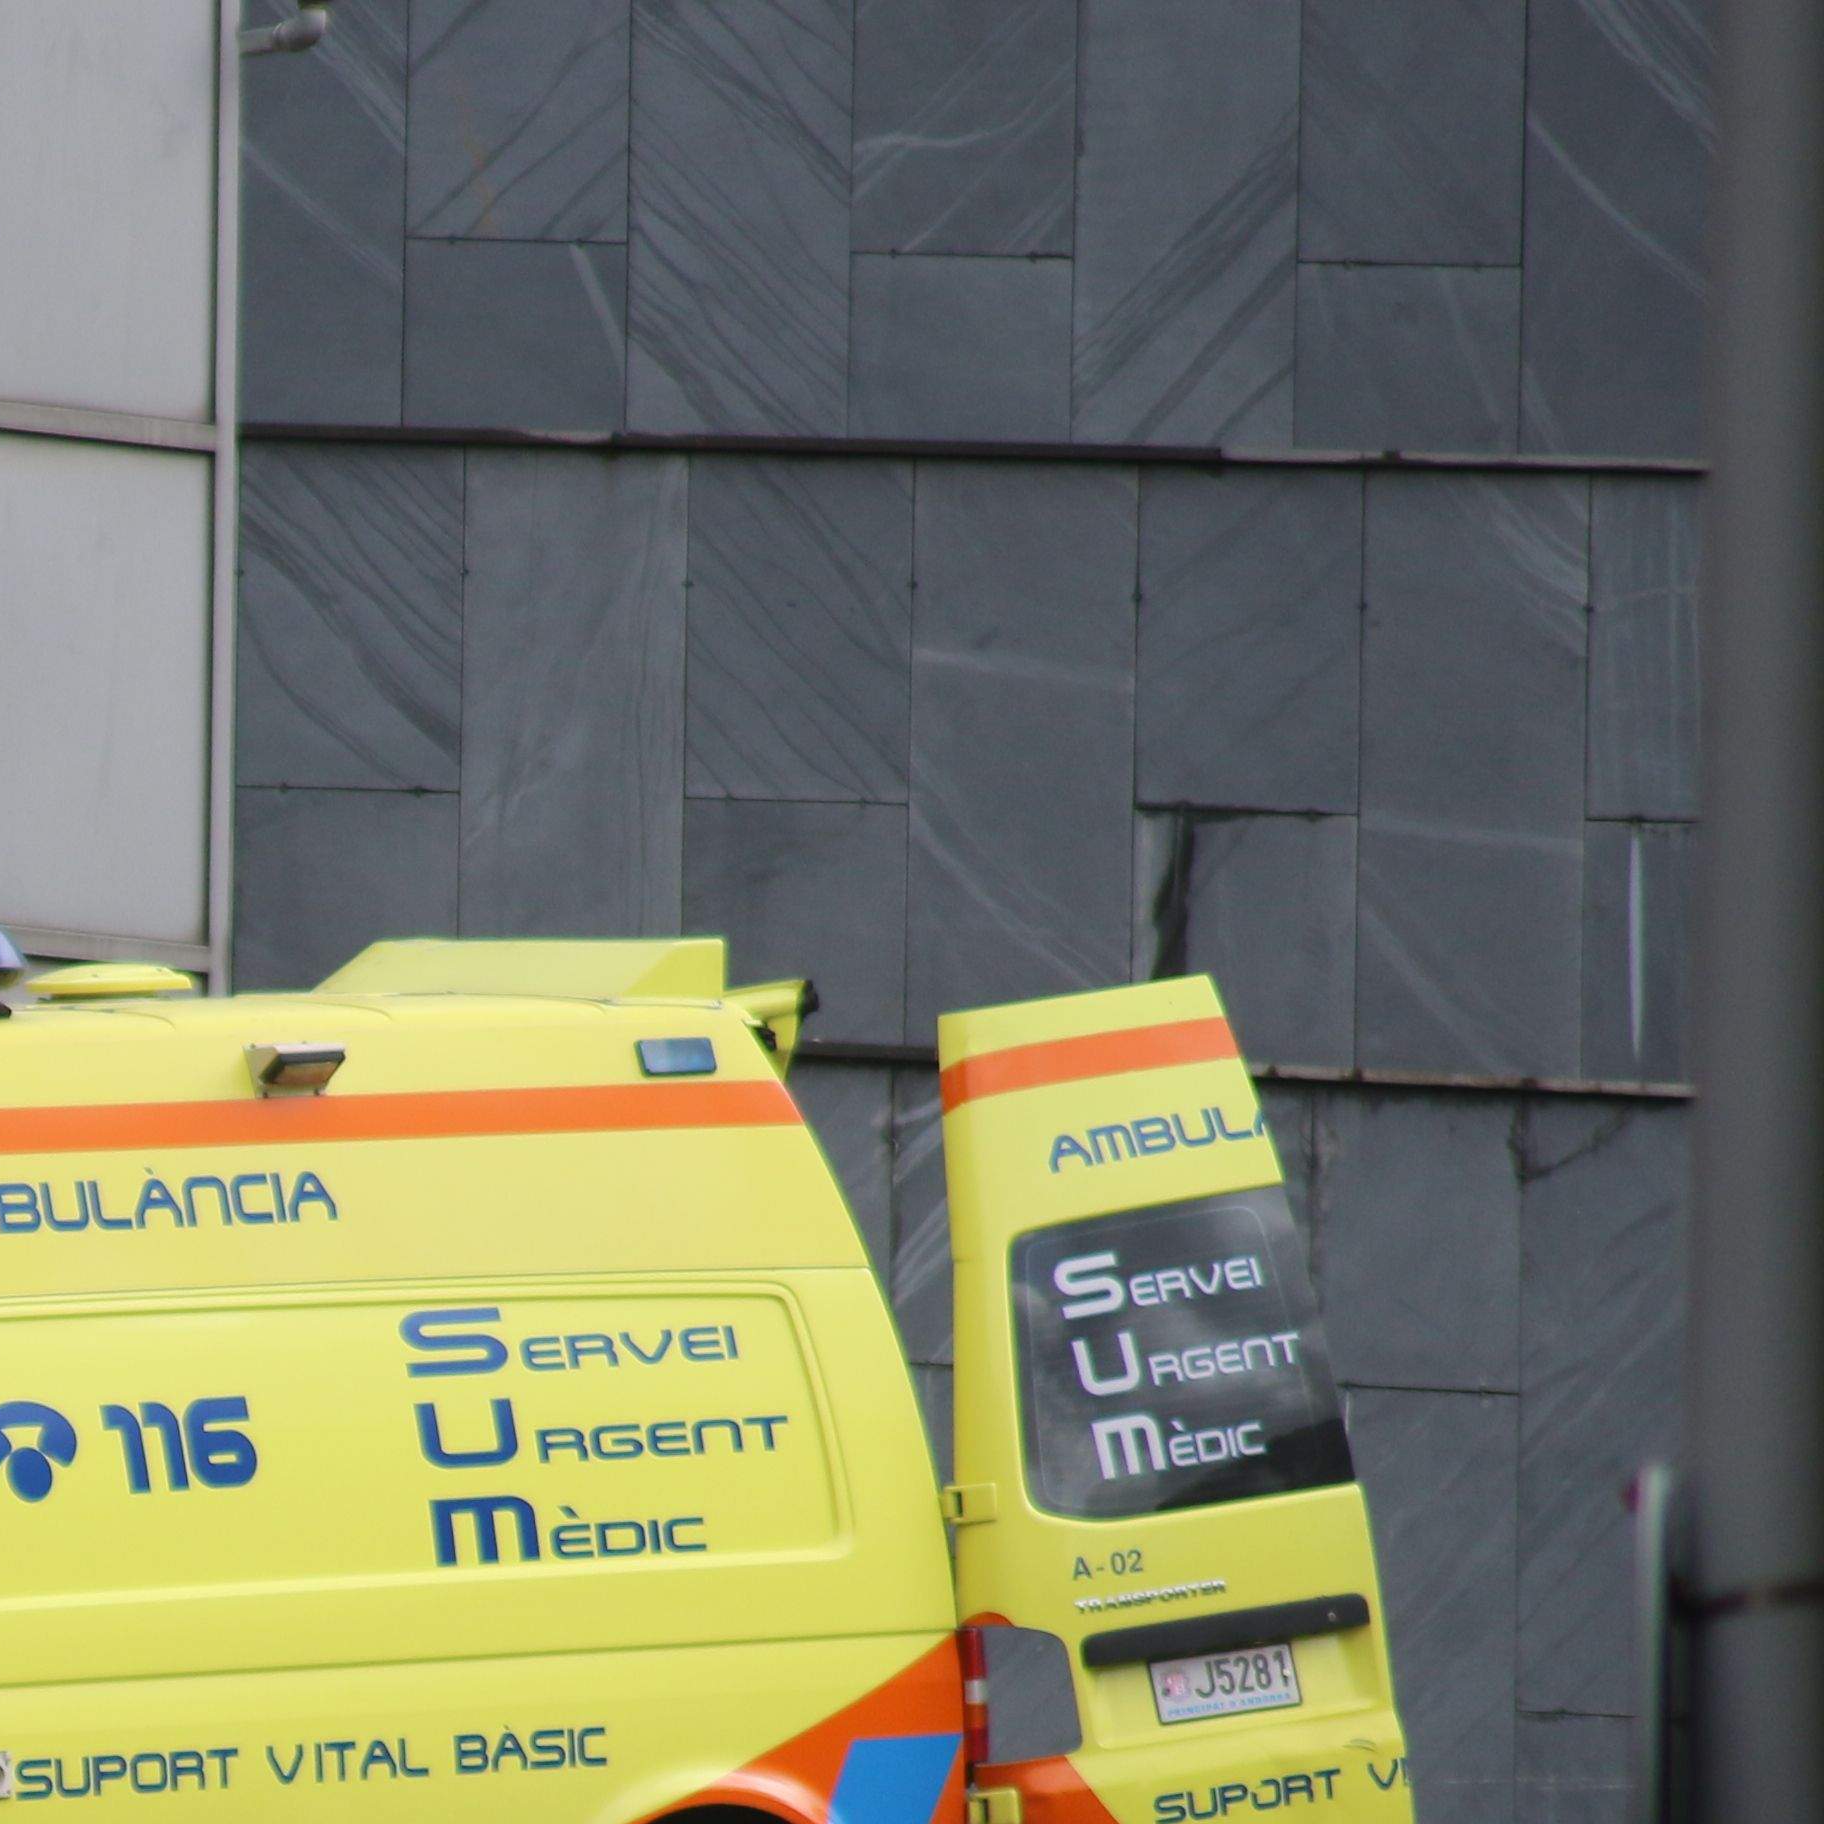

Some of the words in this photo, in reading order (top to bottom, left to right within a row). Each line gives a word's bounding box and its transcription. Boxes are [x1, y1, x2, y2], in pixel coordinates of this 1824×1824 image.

[1054, 1250, 1266, 1320] SERVEI
[398, 1307, 739, 1379] SERVEI
[1070, 1331, 1301, 1397] URGENT
[99, 1396, 258, 1494] 116
[412, 1397, 789, 1471] URGENT
[1194, 1650, 1290, 1698] J5281
[16, 1747, 239, 1800] SUPORT
[266, 1737, 430, 1785] VITAL
[454, 1723, 608, 1775] BÀSIC
